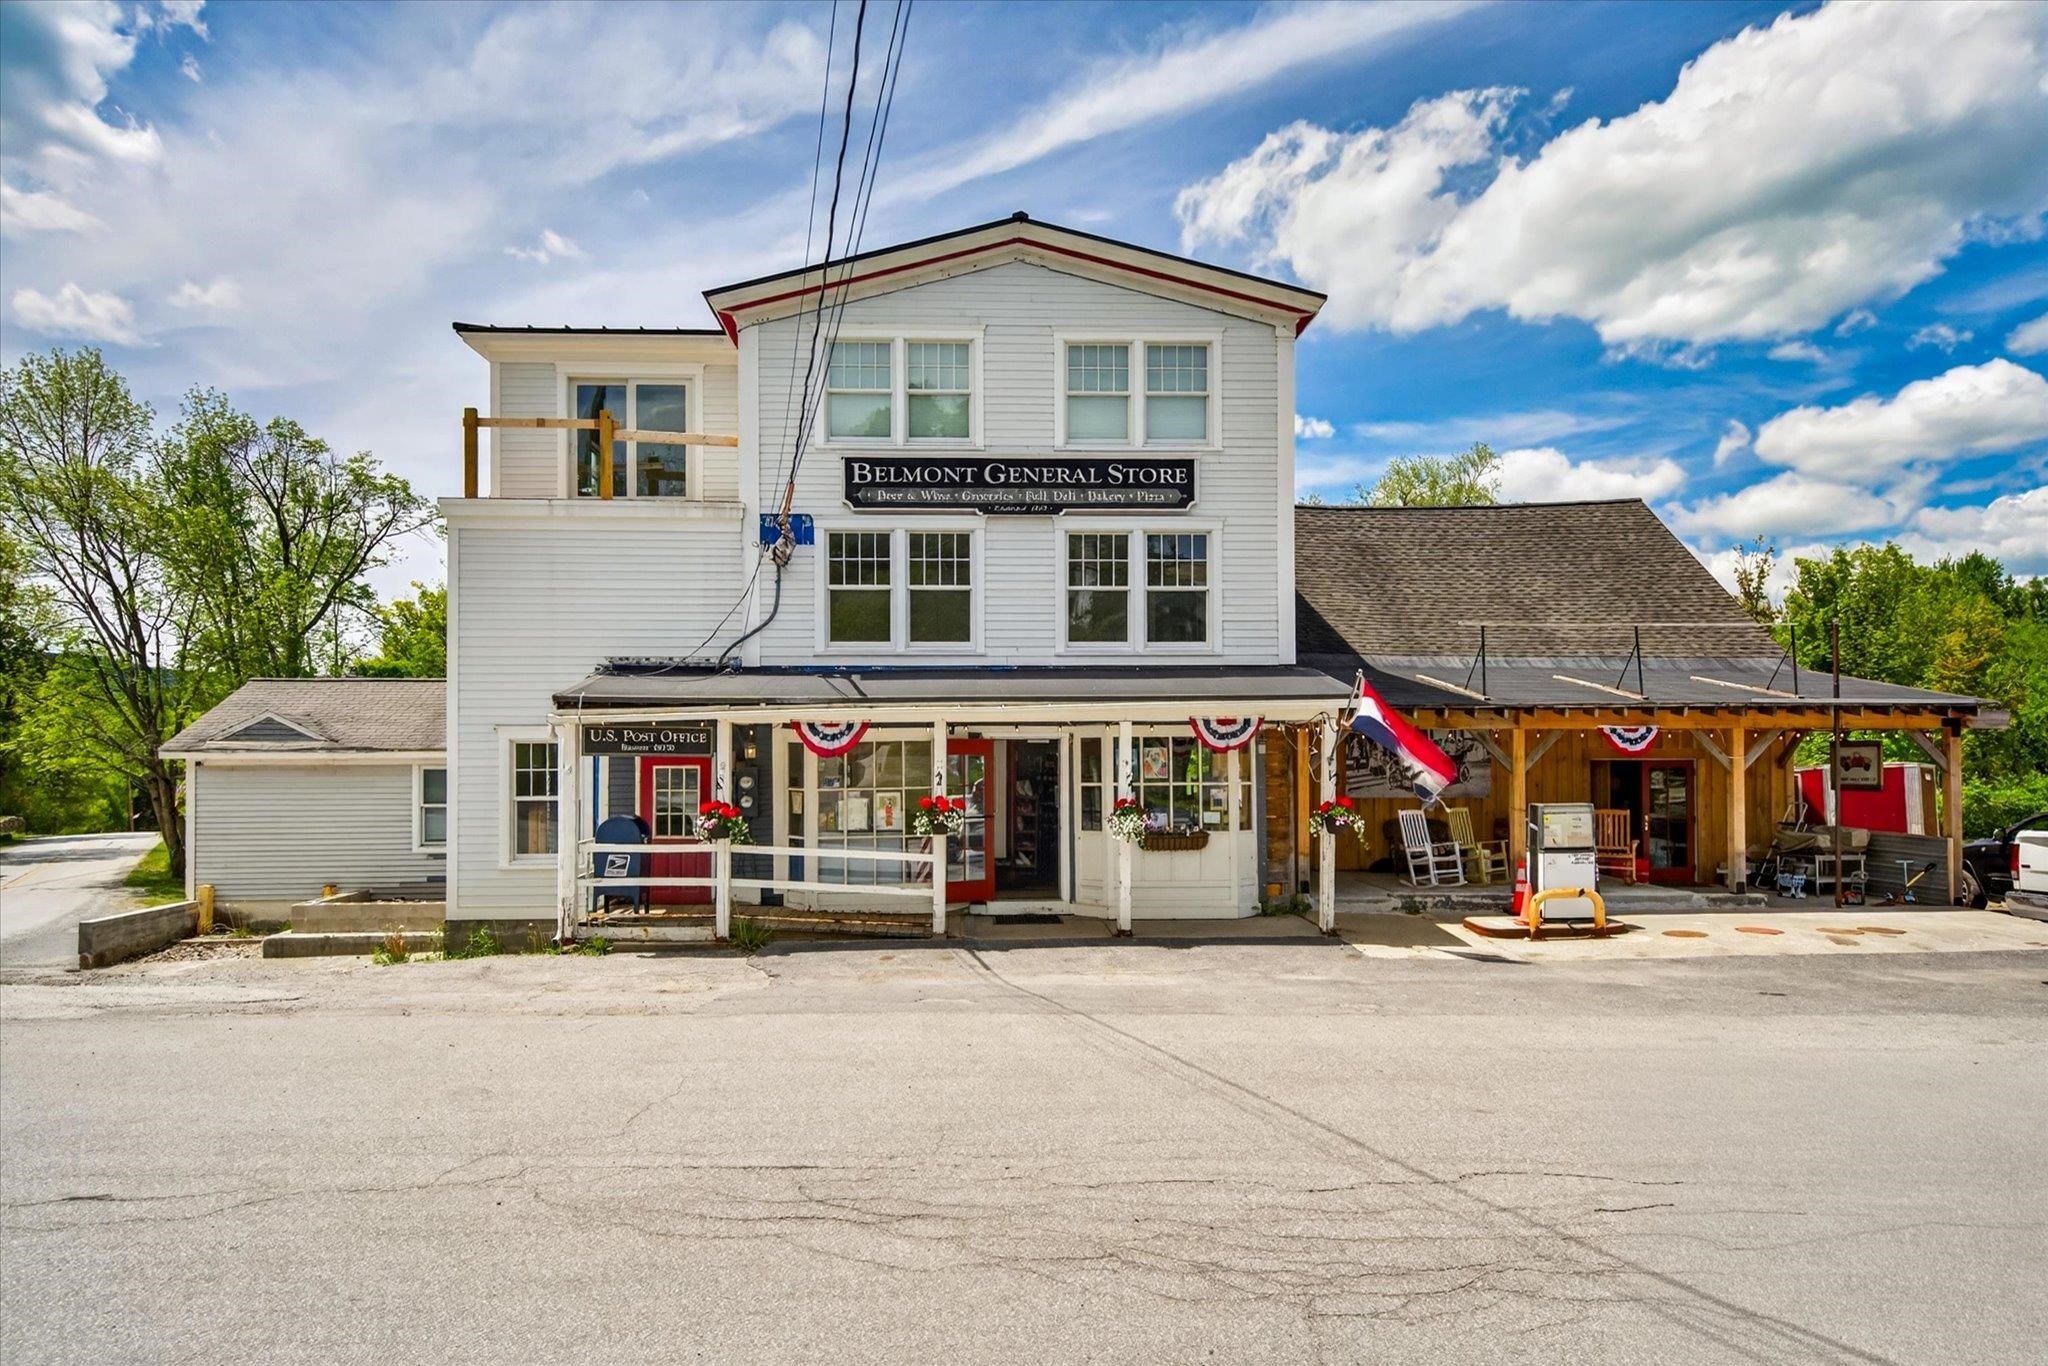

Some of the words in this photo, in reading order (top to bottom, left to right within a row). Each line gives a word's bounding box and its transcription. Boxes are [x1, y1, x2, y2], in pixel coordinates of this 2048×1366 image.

[851, 462, 977, 484] BELMONT
[983, 463, 1103, 485] GENERAL
[1107, 463, 1188, 485] STORE
[961, 490, 1014, 501] Groceries
[1025, 489, 1048, 502] Full
[1053, 490, 1076, 501] Deli
[1088, 489, 1126, 504] Bakery
[1137, 489, 1165, 502] Pizza
[590, 729, 618, 742] U.S.
[623, 729, 657, 743] POST
[660, 729, 707, 744] OFFICE
